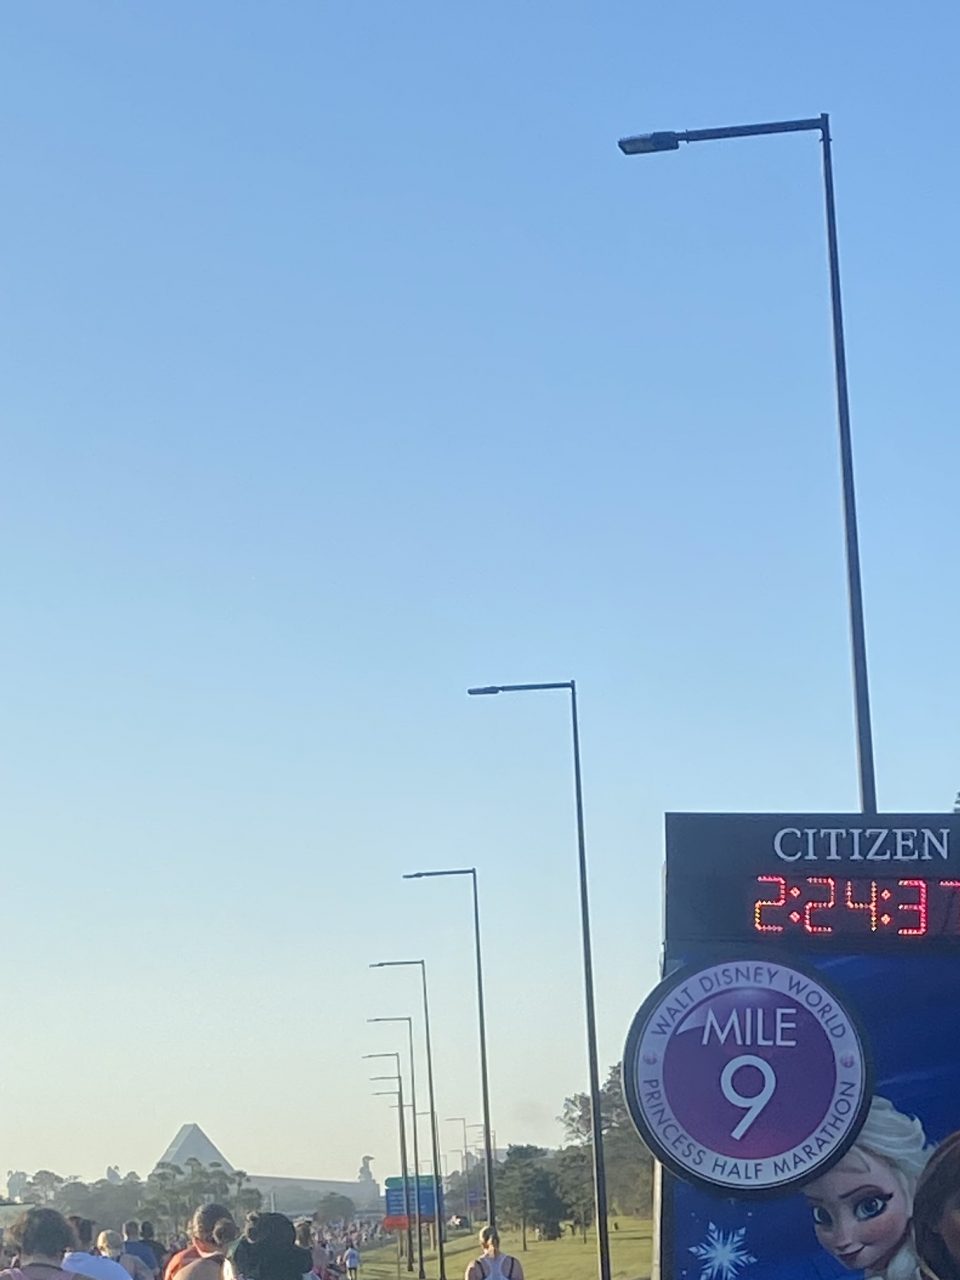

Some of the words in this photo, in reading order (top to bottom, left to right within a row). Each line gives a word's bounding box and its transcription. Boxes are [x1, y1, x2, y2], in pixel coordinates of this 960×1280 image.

[773, 827, 951, 861] CITIZEN
[651, 987, 696, 1036] WALT
[698, 966, 779, 993] DISNEY
[788, 974, 846, 1038] WORLD
[701, 1007, 797, 1047] MILE
[643, 1079, 707, 1166] PRINCESS
[711, 1156, 763, 1180] HALF
[772, 1081, 857, 1177] MARATHON
[720, 1054, 777, 1141] 9
